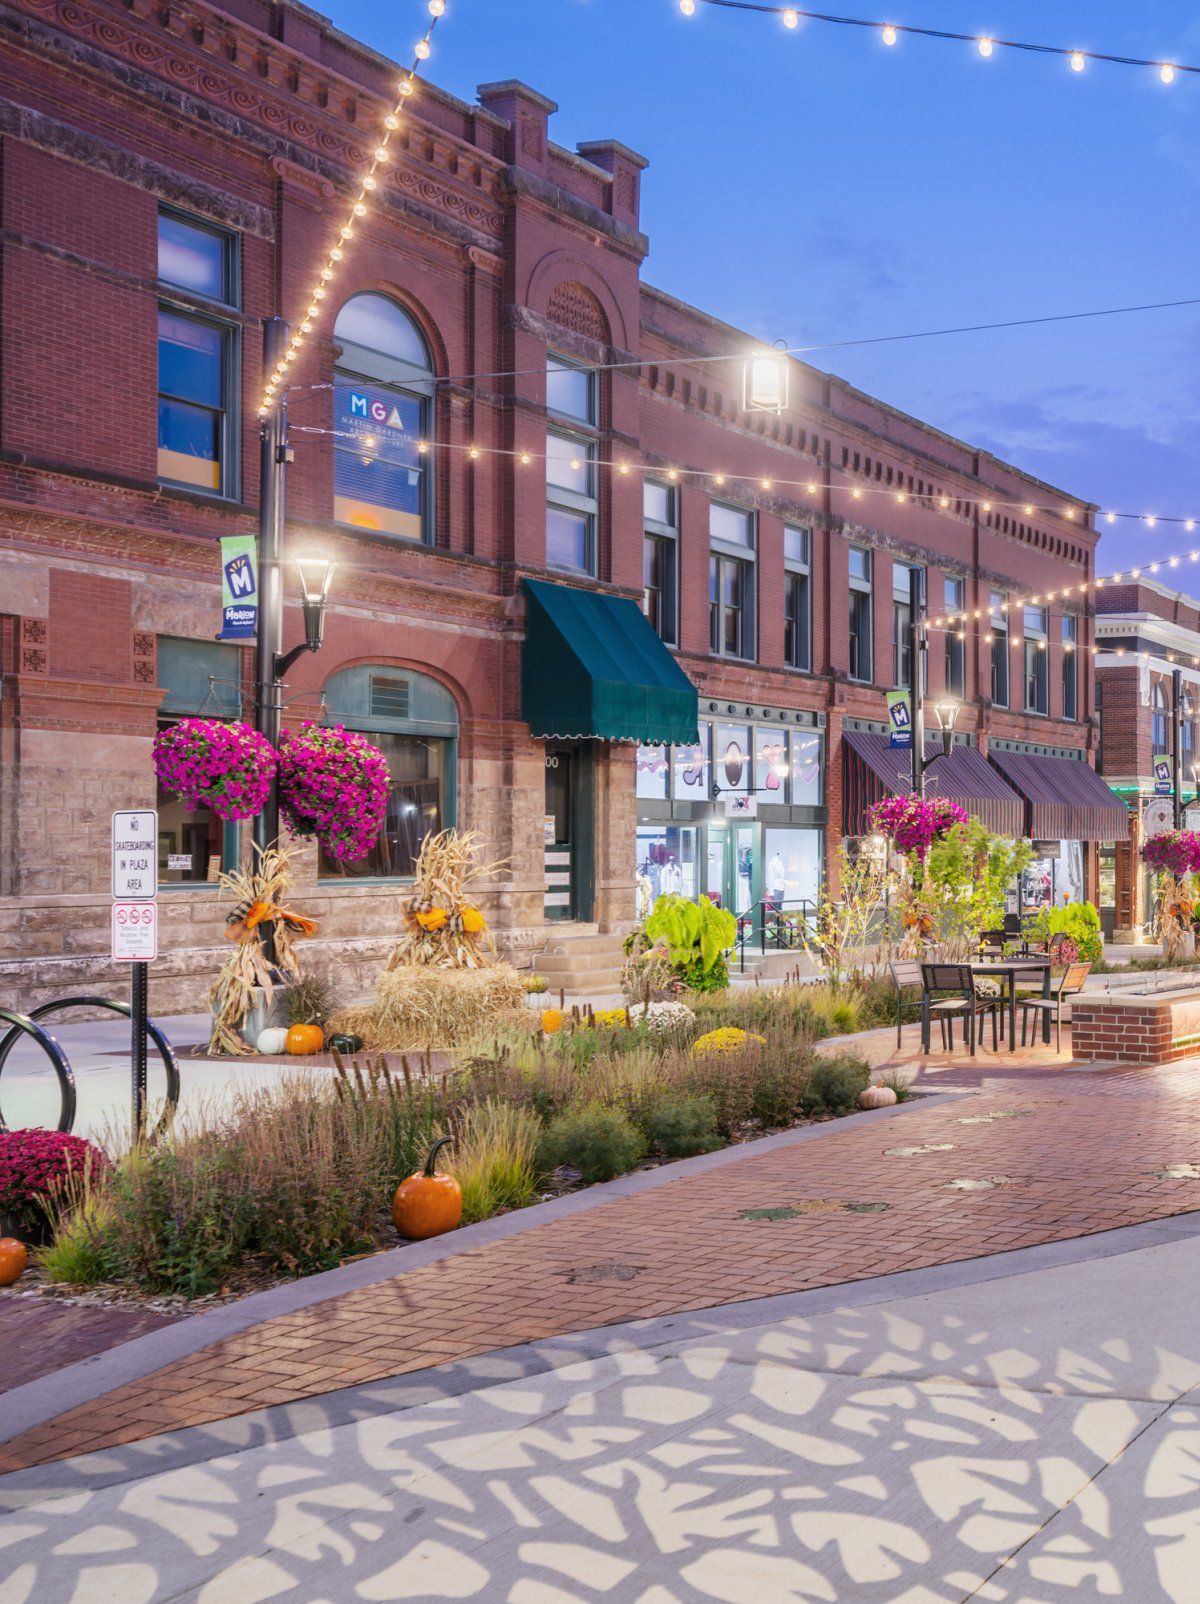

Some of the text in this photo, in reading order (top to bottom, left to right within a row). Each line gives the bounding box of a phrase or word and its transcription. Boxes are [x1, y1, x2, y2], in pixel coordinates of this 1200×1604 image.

[351, 394, 403, 430] MGA
[231, 566, 252, 595] M
[894, 708, 908, 726] M
[1158, 767, 1169, 779] M
[130, 820, 139, 831] NO
[115, 841, 155, 851] SKATEBOARDING
[121, 860, 148, 870] IN PLAZA
[127, 879, 142, 890] AREA
